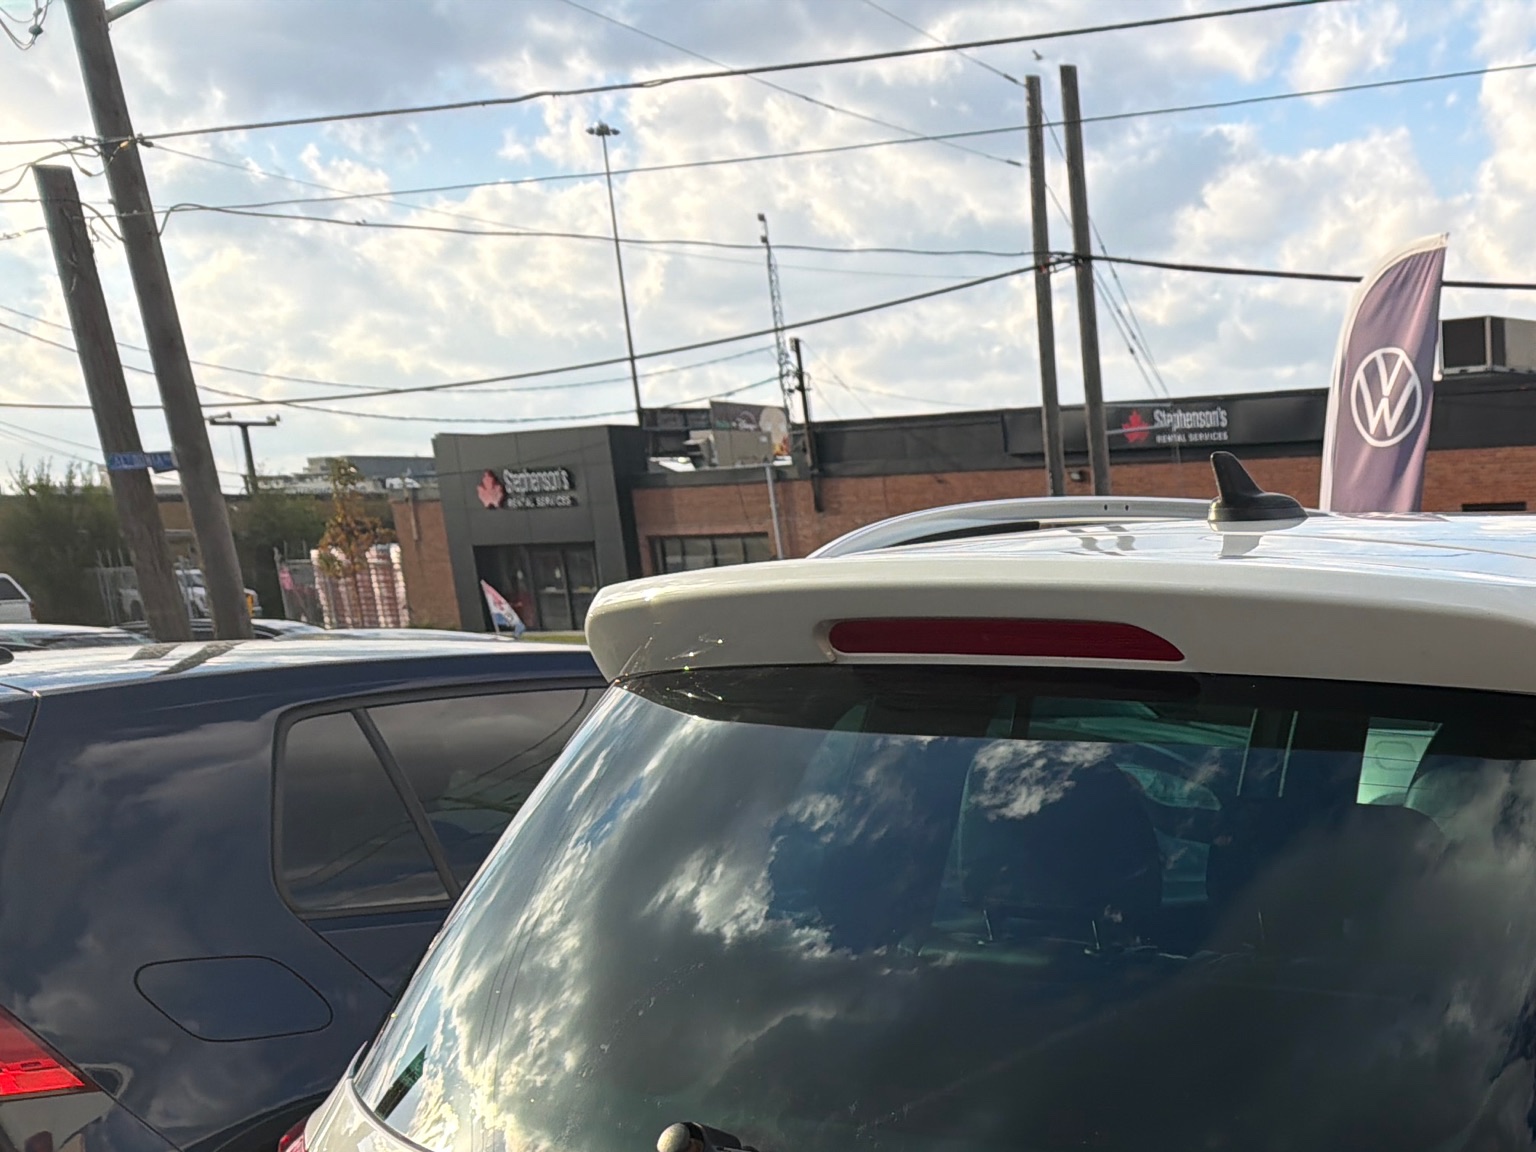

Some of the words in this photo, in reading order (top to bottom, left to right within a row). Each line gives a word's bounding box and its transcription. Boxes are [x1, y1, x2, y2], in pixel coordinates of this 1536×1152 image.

[1153, 407, 1228, 431] Stephenson's
[1156, 433, 1187, 444] RENTAL
[1188, 431, 1229, 442] SERVICES
